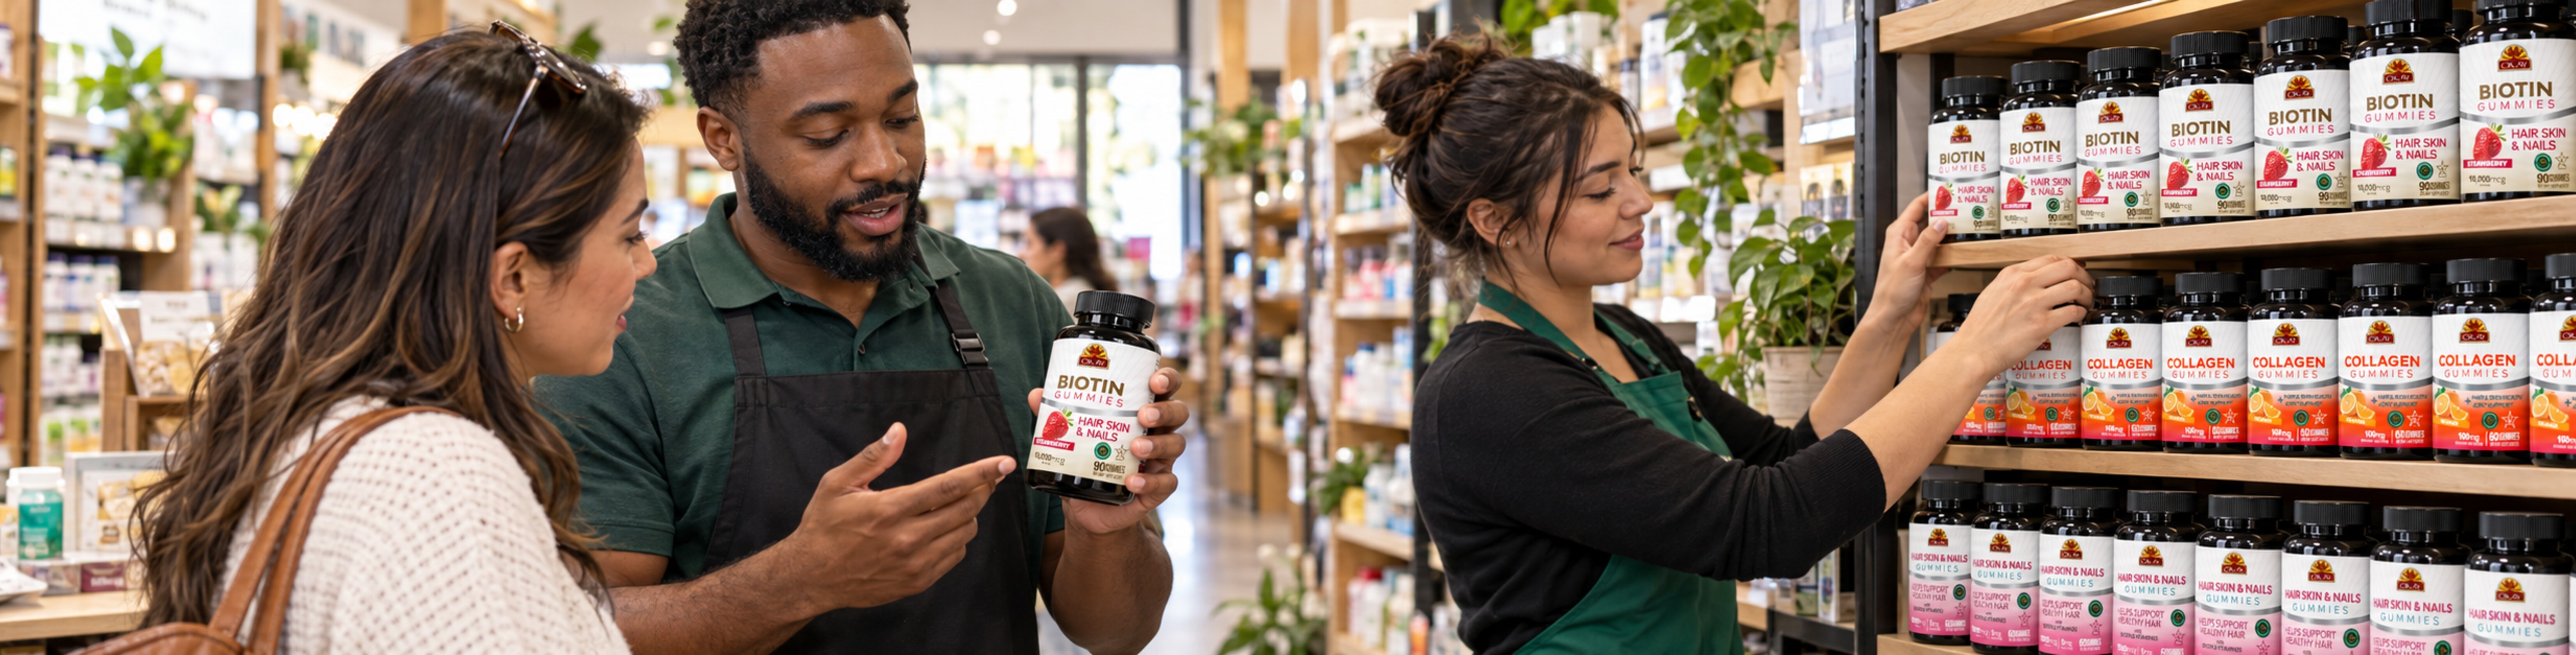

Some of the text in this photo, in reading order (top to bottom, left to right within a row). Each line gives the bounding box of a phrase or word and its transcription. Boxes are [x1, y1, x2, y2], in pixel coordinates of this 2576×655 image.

[2480, 81, 2552, 100] BIOTIN
[2366, 94, 2433, 111] BIOTIN
[2478, 99, 2555, 111] GUMMIES
[2269, 108, 2331, 126] BIOTIN
[2365, 111, 2436, 123] GUMMIES
[2171, 120, 2230, 137] BIOTIN
[2267, 124, 2334, 136] GUMMIES
[2511, 128, 2565, 138] HAIR SKIN
[2086, 131, 2139, 147] BIOTIN
[2170, 136, 2232, 147] GUMMIES
[2396, 138, 2446, 148] HAIR SKIN
[2010, 141, 2060, 155] BIOTIN
[2511, 140, 2556, 150] & NAILS
[2085, 146, 2141, 157] GUMMIES
[2297, 151, 2343, 160] HAIR SKIN
[2396, 150, 2437, 159] & NAILS
[1940, 151, 1985, 165] BIOTIN
[2009, 155, 2062, 165] GUMMIES
[2197, 161, 2242, 170] HAIR SKIN
[2297, 162, 2335, 172] & NAILS
[2108, 170, 2150, 179] HAIR SKIN
[2206, 172, 2233, 181] NAILS
[2116, 181, 2142, 189] NAILS
[2088, 359, 2152, 369] COLLAGEN
[2167, 358, 2235, 368] COLLAGEN
[2253, 357, 2325, 368] COLLAGEN
[2345, 356, 2420, 367] COLLAGEN
[2439, 354, 2516, 366] COLLAGEN
[2172, 370, 2229, 379] GUMMIES
[2258, 370, 2318, 378] GUMMIES
[2350, 370, 2413, 378] GUMMIES
[2444, 369, 2508, 378] GUMMIES
[2543, 369, 2576, 378] GUM
[1057, 375, 1124, 396] BIOTIN
[1054, 391, 1123, 407] GUMMIES
[1078, 416, 1130, 433] HAIR SKIN
[1076, 427, 1118, 442] & NAILS
[1093, 461, 1106, 471] 90
[1947, 554, 1968, 563] NAILS
[2009, 561, 2032, 570] NAILS
[2081, 568, 2104, 577] NAILS
[2047, 577, 2093, 587] GUMMIES
[2118, 573, 2132, 582] HAIR
[2161, 575, 2186, 585] NAILS
[2124, 585, 2175, 596] GUMMIES
[2199, 581, 2272, 595] HAIR SKIN & NAILS
[2206, 594, 2260, 605] GUMMIES
[2285, 589, 2361, 603] HAIR SKIN & NAILS
[2292, 602, 2348, 614] GUMMIES
[2373, 598, 2452, 613] HAIR SKIN & NAILS
[2380, 612, 2440, 625] GUMMIES
[2469, 609, 2555, 625] HAIR SKIN & NAILS
[2477, 623, 2541, 637] GUMMIES
